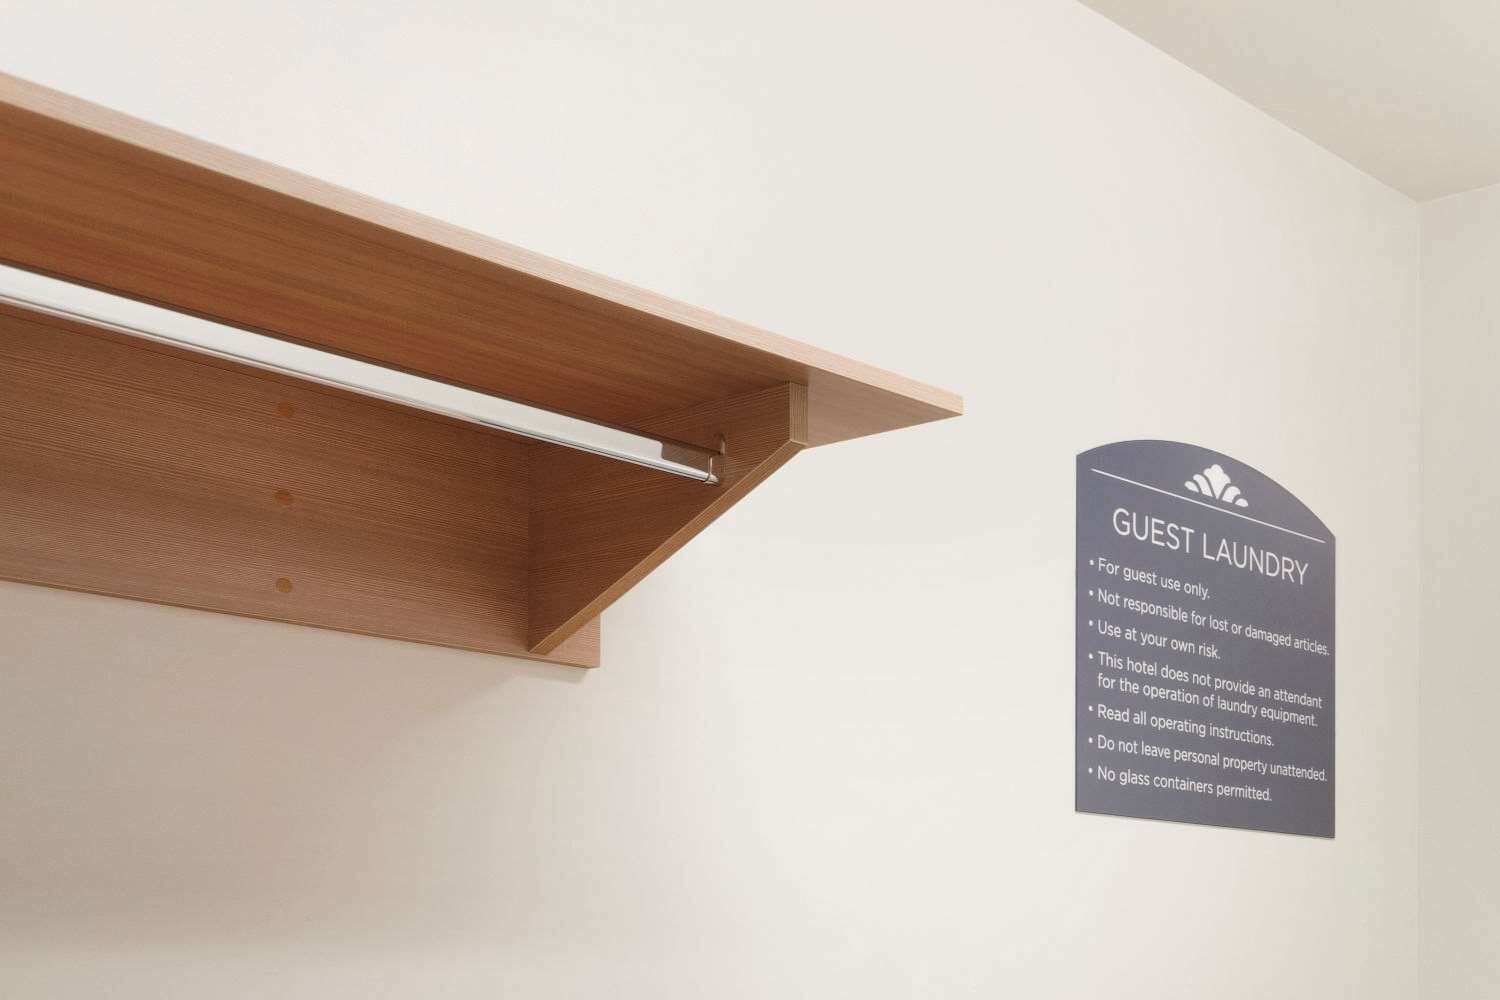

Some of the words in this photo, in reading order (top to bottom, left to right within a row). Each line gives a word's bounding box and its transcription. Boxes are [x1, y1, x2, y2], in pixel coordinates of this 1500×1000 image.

[1112, 507, 1195, 553] GUEST
[1202, 532, 1309, 585] LAUNDRY
[1098, 558, 1120, 576] For
[1123, 566, 1158, 586] guest
[1160, 576, 1181, 592] use
[1183, 582, 1211, 600] only.
[1098, 589, 1120, 607] Not
[1123, 597, 1188, 623] responsible
[1191, 611, 1207, 626] for
[1209, 615, 1229, 632] lost
[1231, 624, 1242, 635] or
[1245, 624, 1292, 648] damaged
[1294, 638, 1331, 656] articles.
[1098, 620, 1121, 638] Use
[1124, 627, 1137, 640] at
[1140, 630, 1168, 648] your
[1170, 638, 1195, 654] own
[1198, 642, 1221, 660] risk.
[1097, 673, 1116, 689] for
[1119, 678, 1140, 694] the
[1143, 684, 1200, 705] operation
[1203, 694, 1215, 707] of
[1217, 696, 1258, 718] laundry
[1260, 708, 1319, 727] equipment.
[1098, 651, 1123, 670] This
[1127, 657, 1158, 677] hotel
[1160, 664, 1189, 682] does
[1192, 673, 1211, 687] not
[1214, 676, 1256, 696] provide
[1258, 687, 1270, 698] an
[1273, 690, 1323, 709] attendant
[1097, 704, 1130, 723] Read
[1133, 711, 1147, 726] all
[1150, 715, 1206, 738] operating
[1209, 722, 1275, 747] instructions.
[1097, 734, 1115, 751] Do
[1118, 740, 1138, 755] not
[1141, 742, 1171, 759] leave
[1173, 748, 1221, 766] personal
[1223, 757, 1268, 774] property
[1270, 762, 1328, 782] unattended.
[1097, 765, 1116, 782] No
[1119, 768, 1150, 786] glass
[1153, 775, 1214, 794] containers
[1216, 783, 1273, 802] permitted.
